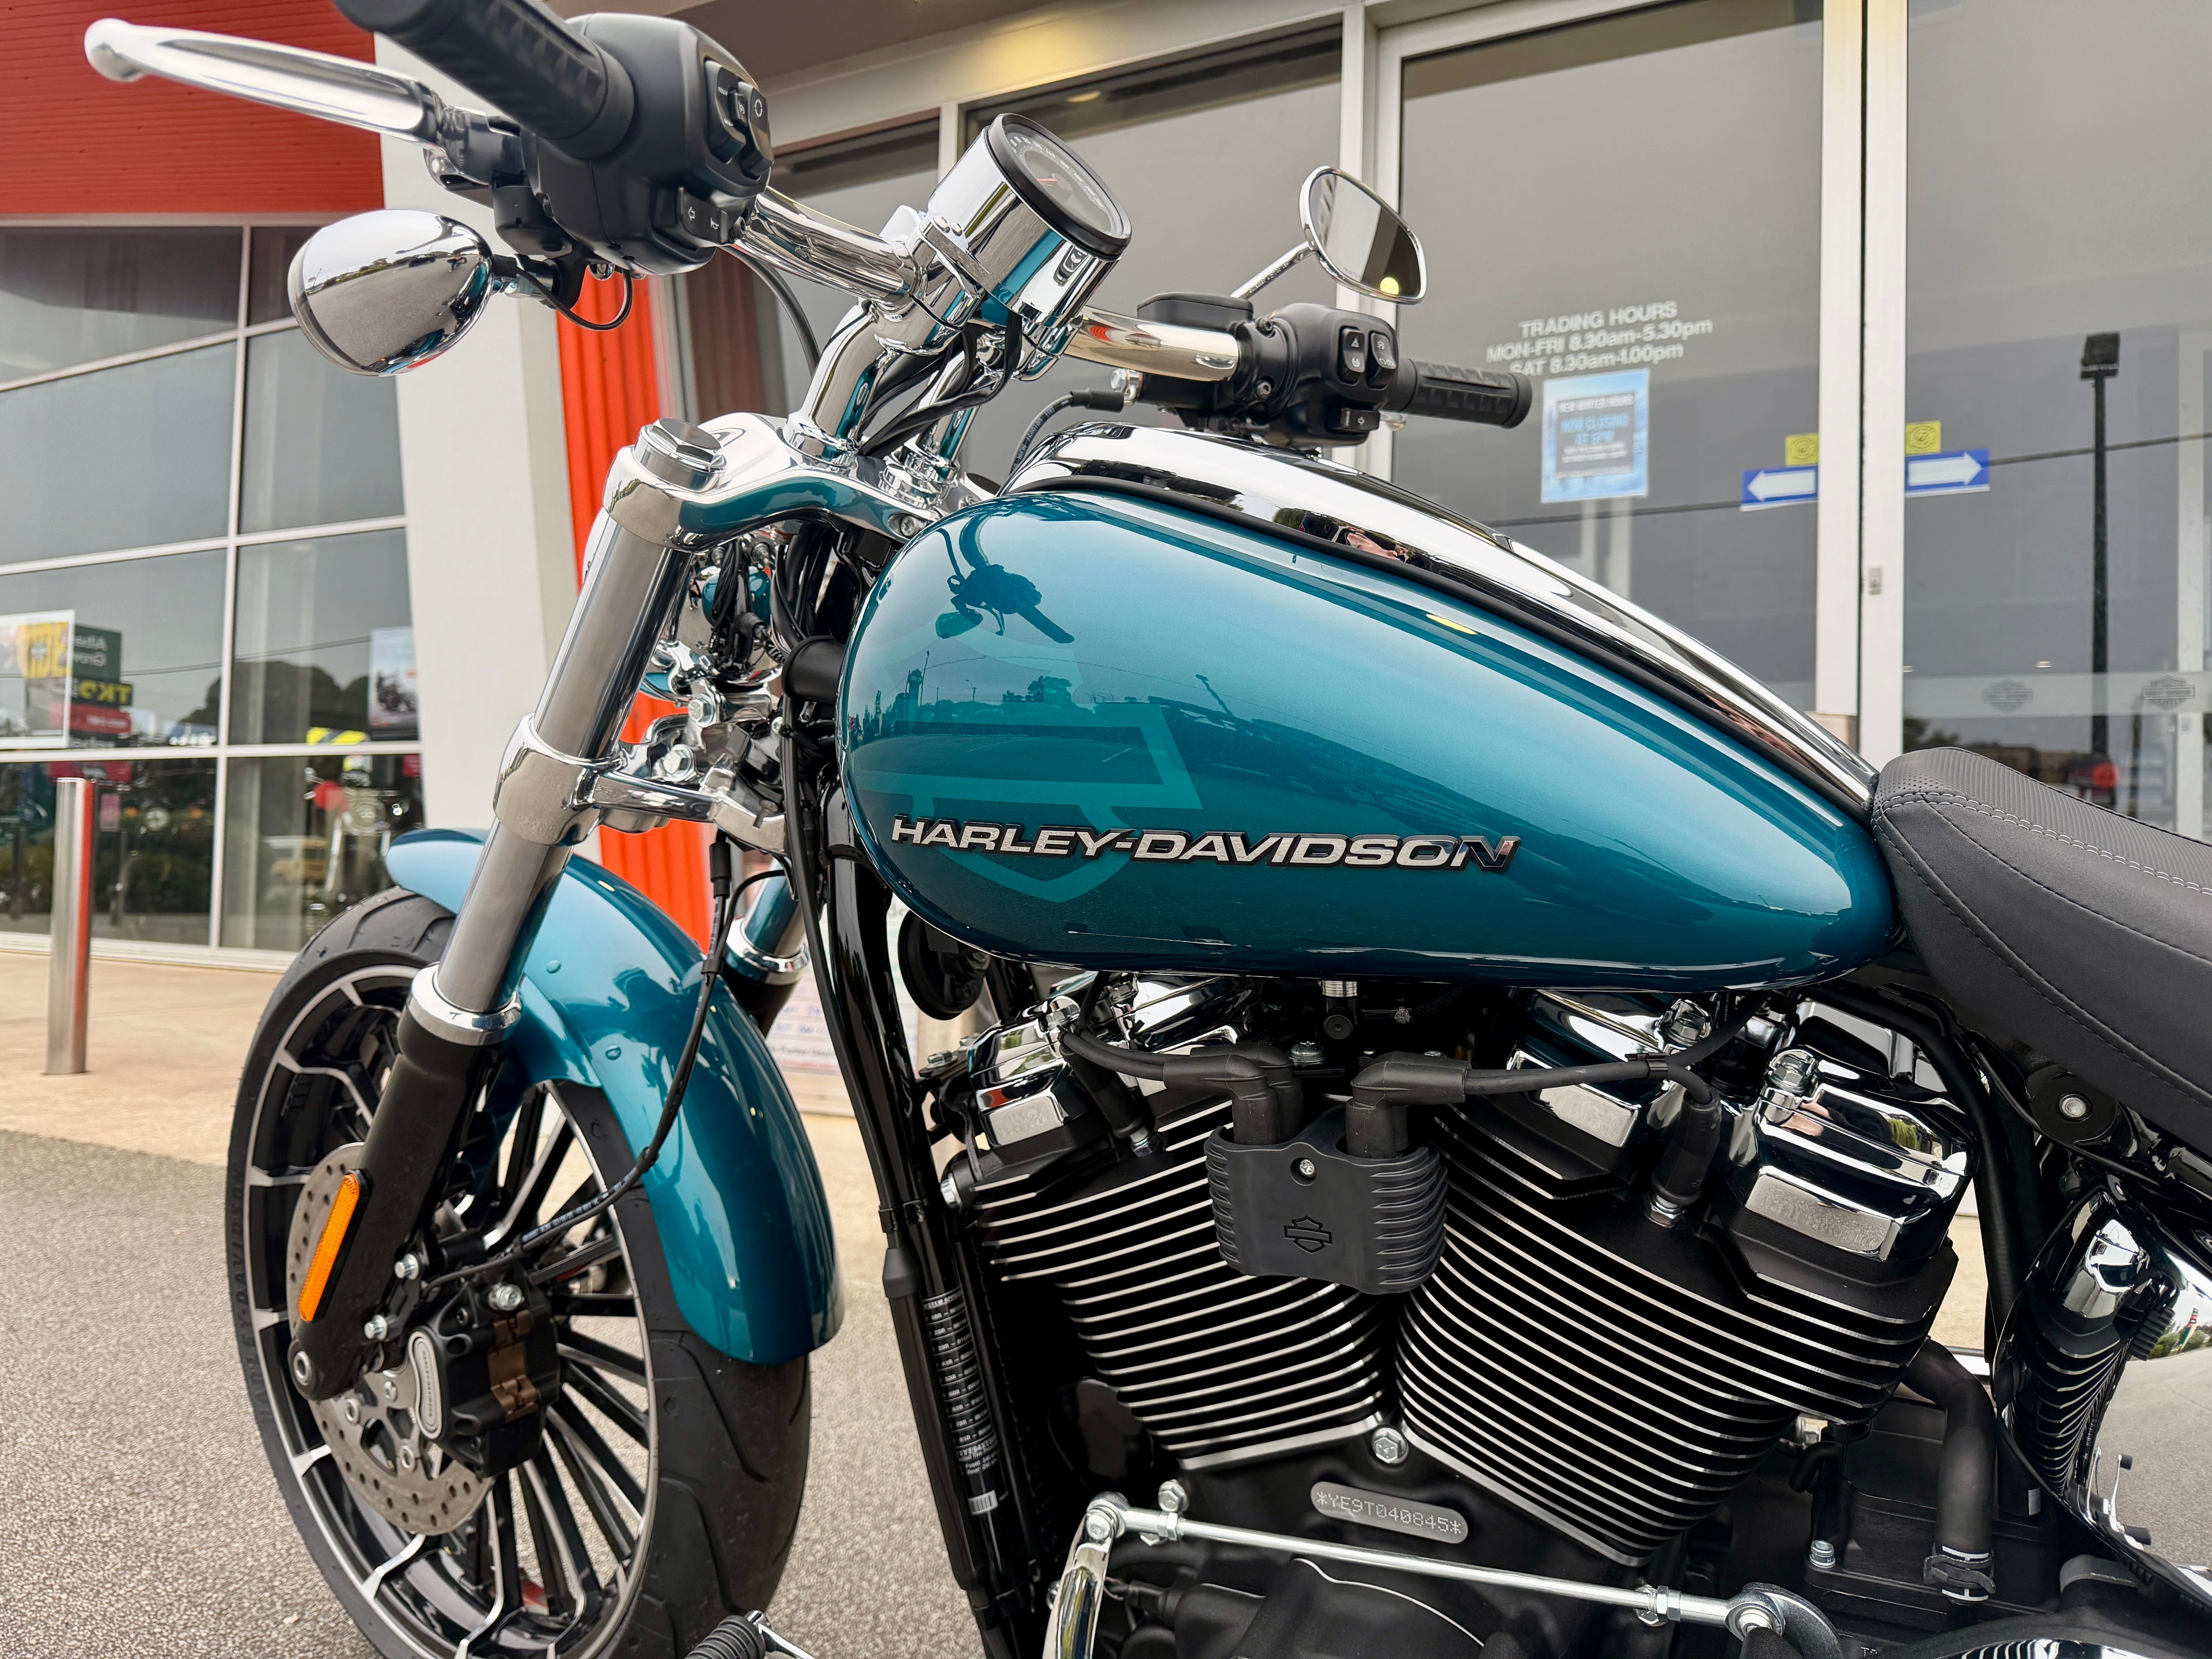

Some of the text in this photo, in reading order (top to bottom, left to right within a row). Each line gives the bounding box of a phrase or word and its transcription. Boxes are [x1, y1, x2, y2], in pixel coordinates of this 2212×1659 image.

[1518, 300, 1678, 338] TRADING HOURS
[1486, 319, 1713, 362] MON-FRI 8.30am-5.30pm
[1509, 357, 1547, 376] SAT
[891, 814, 1521, 871] HARLEY-DAVIDSON
